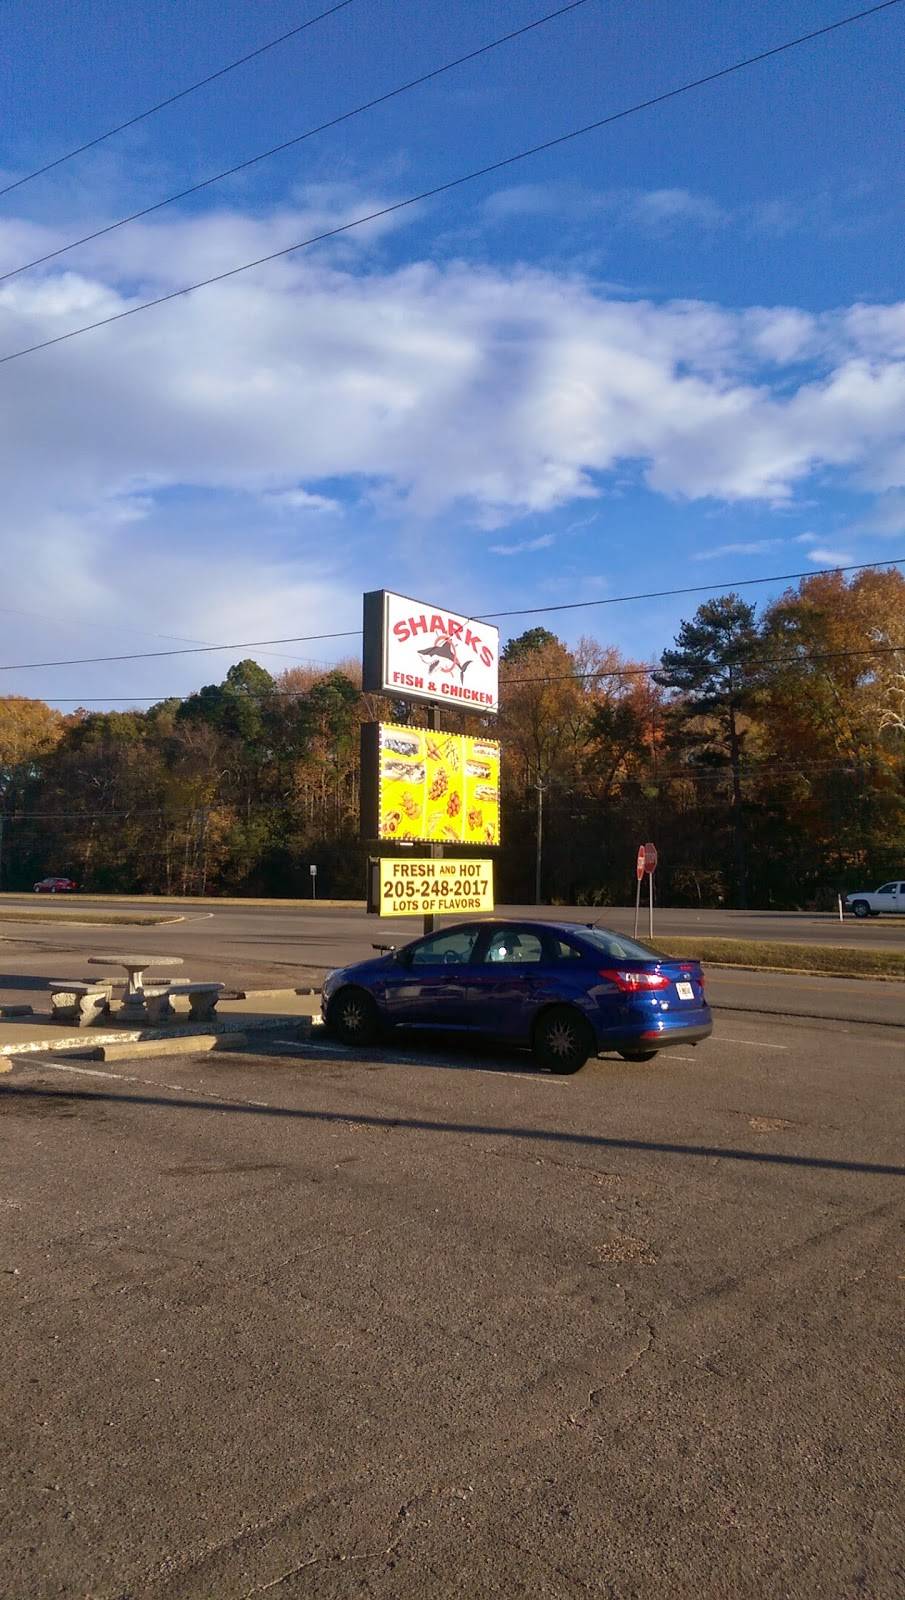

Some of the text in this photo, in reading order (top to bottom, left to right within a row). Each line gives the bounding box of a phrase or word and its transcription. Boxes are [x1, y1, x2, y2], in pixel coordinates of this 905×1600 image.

[393, 615, 494, 667] SHARKS
[393, 671, 493, 705] FISH & CHICKEN
[393, 864, 481, 877] FRESH AND HOT
[384, 880, 488, 898] 205-248-2017
[393, 898, 481, 912] LOTS OF FLAVORS
